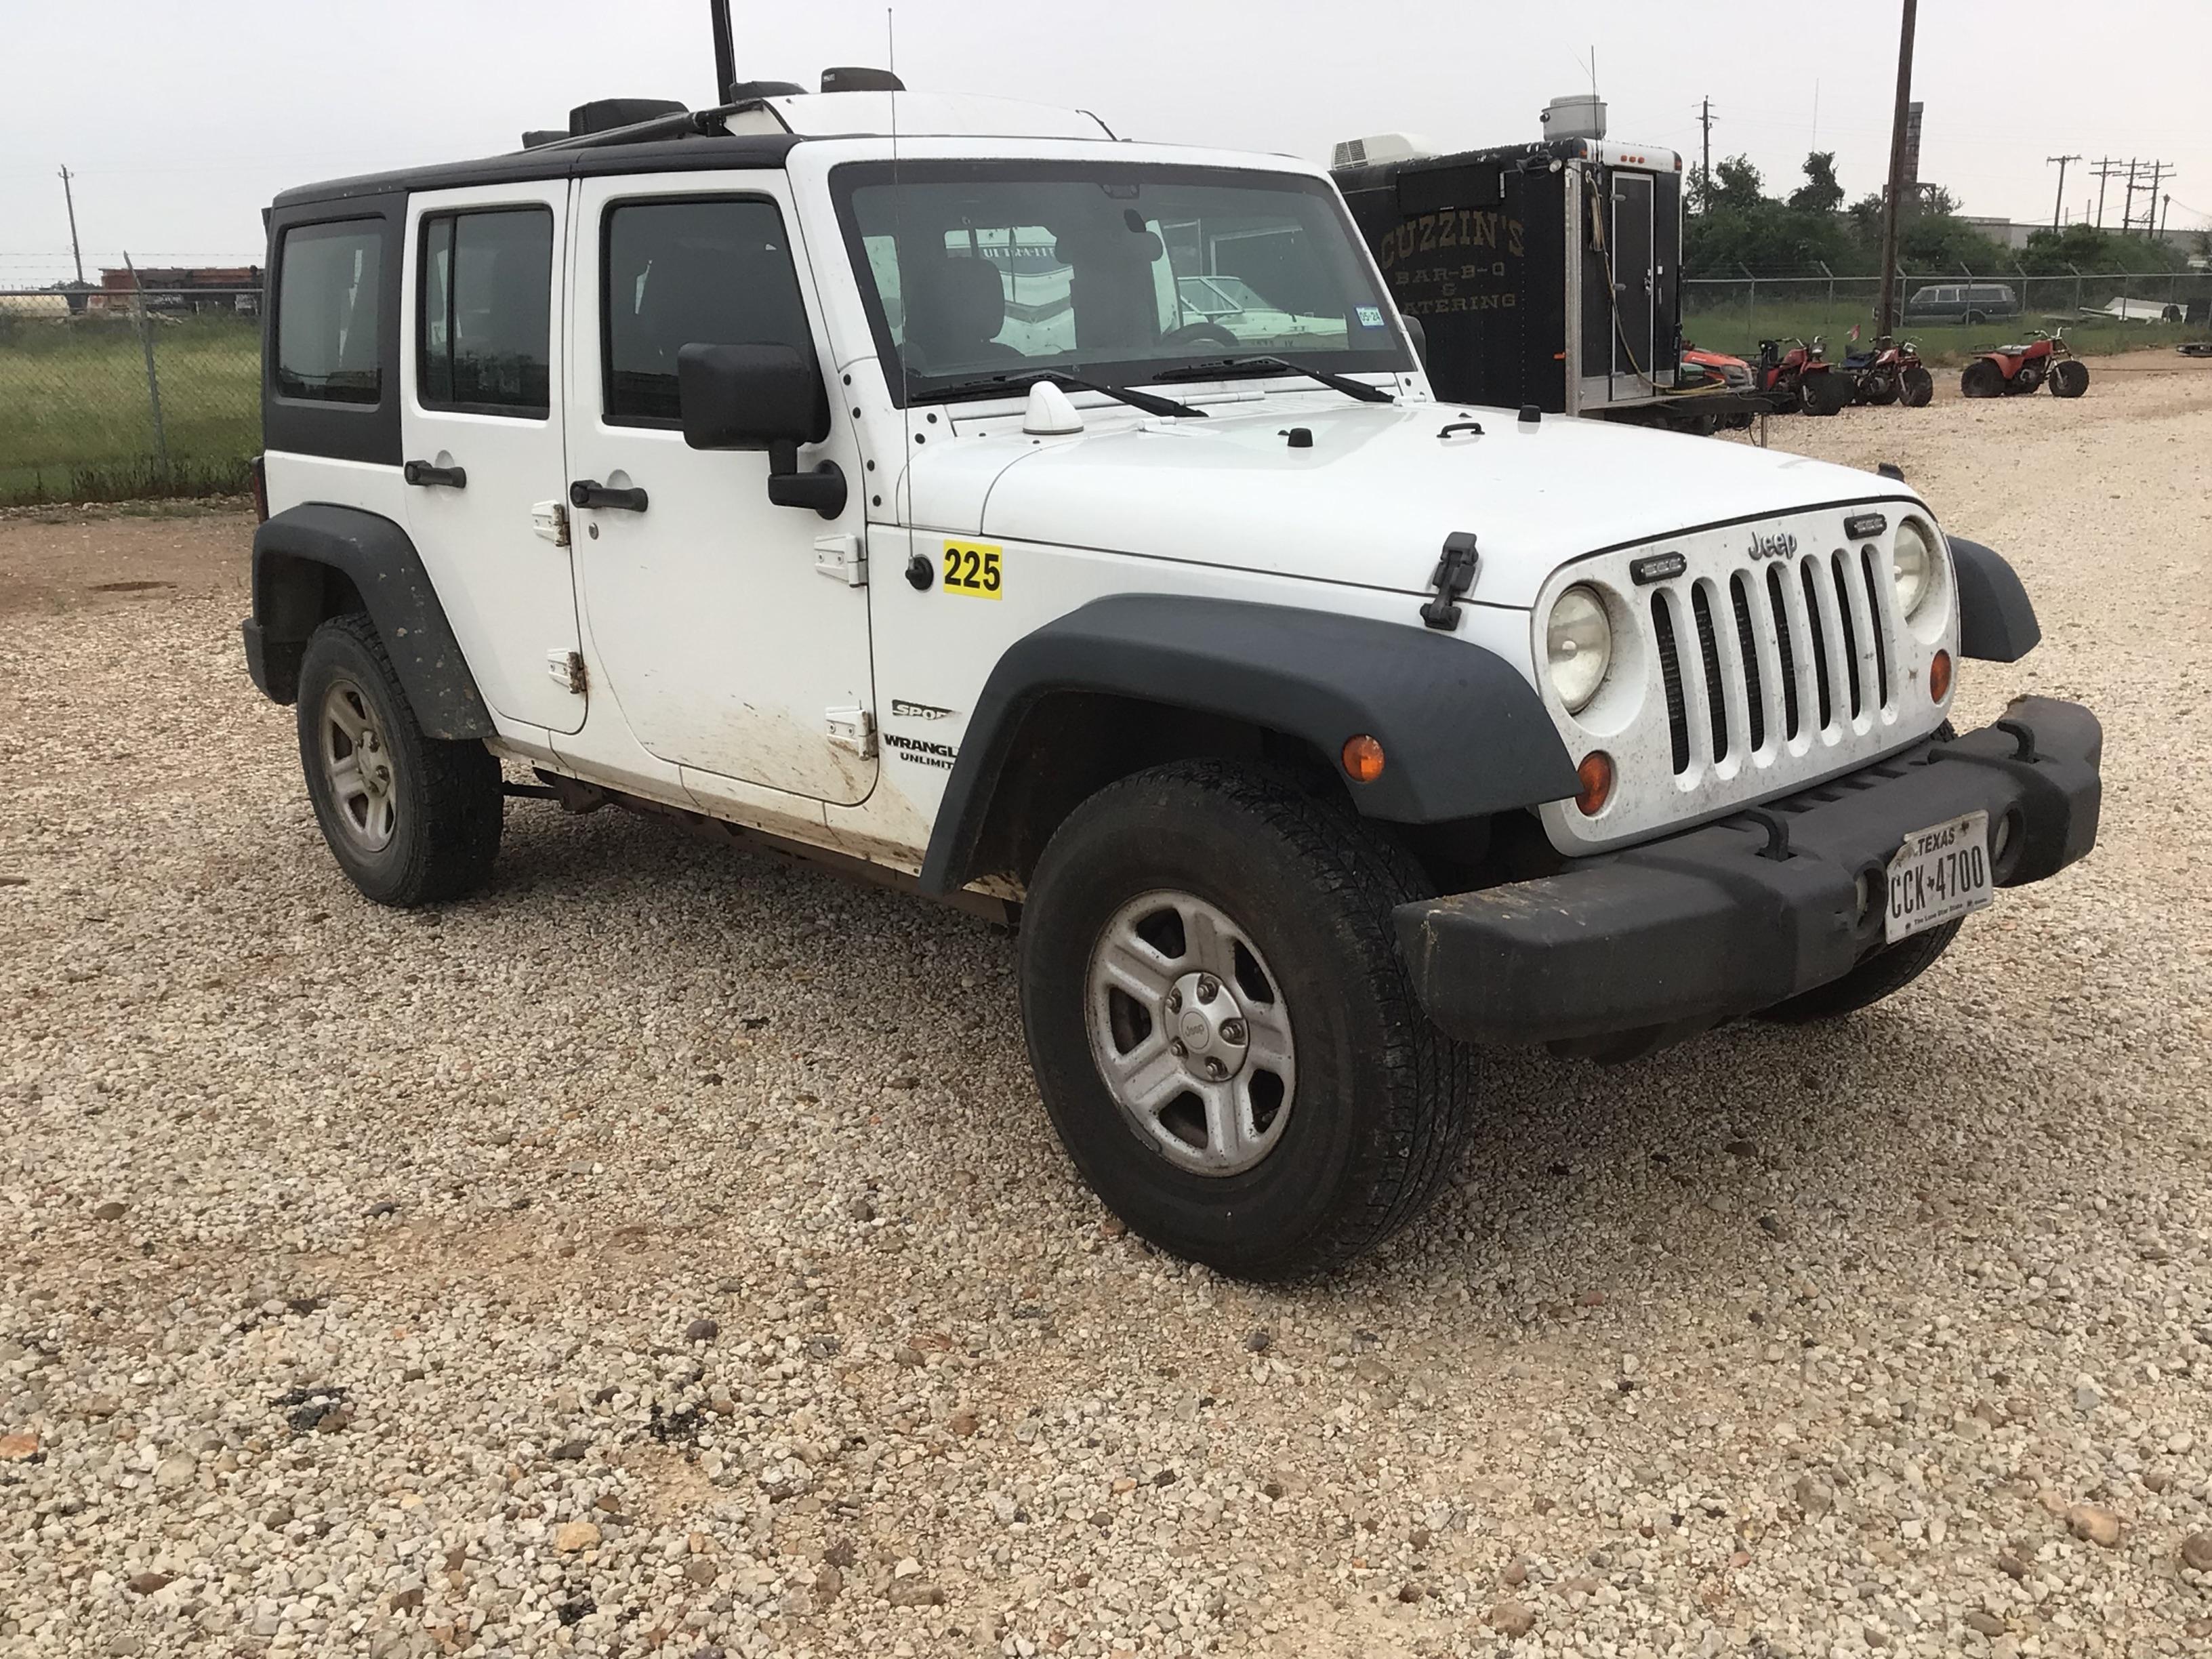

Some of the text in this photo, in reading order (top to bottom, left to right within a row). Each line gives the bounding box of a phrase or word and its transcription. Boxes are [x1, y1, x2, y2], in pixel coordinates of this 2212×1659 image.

[1380, 210, 1524, 270] CUZZIN'S
[1395, 261, 1505, 285] BAR-B-Q
[1402, 293, 1516, 316] ATERING
[1748, 531, 1798, 560] Jeep
[944, 548, 1000, 592] 225
[883, 733, 958, 758] WRANGL
[900, 752, 955, 770] UNLIMIT
[1917, 827, 1956, 857] TEXAS
